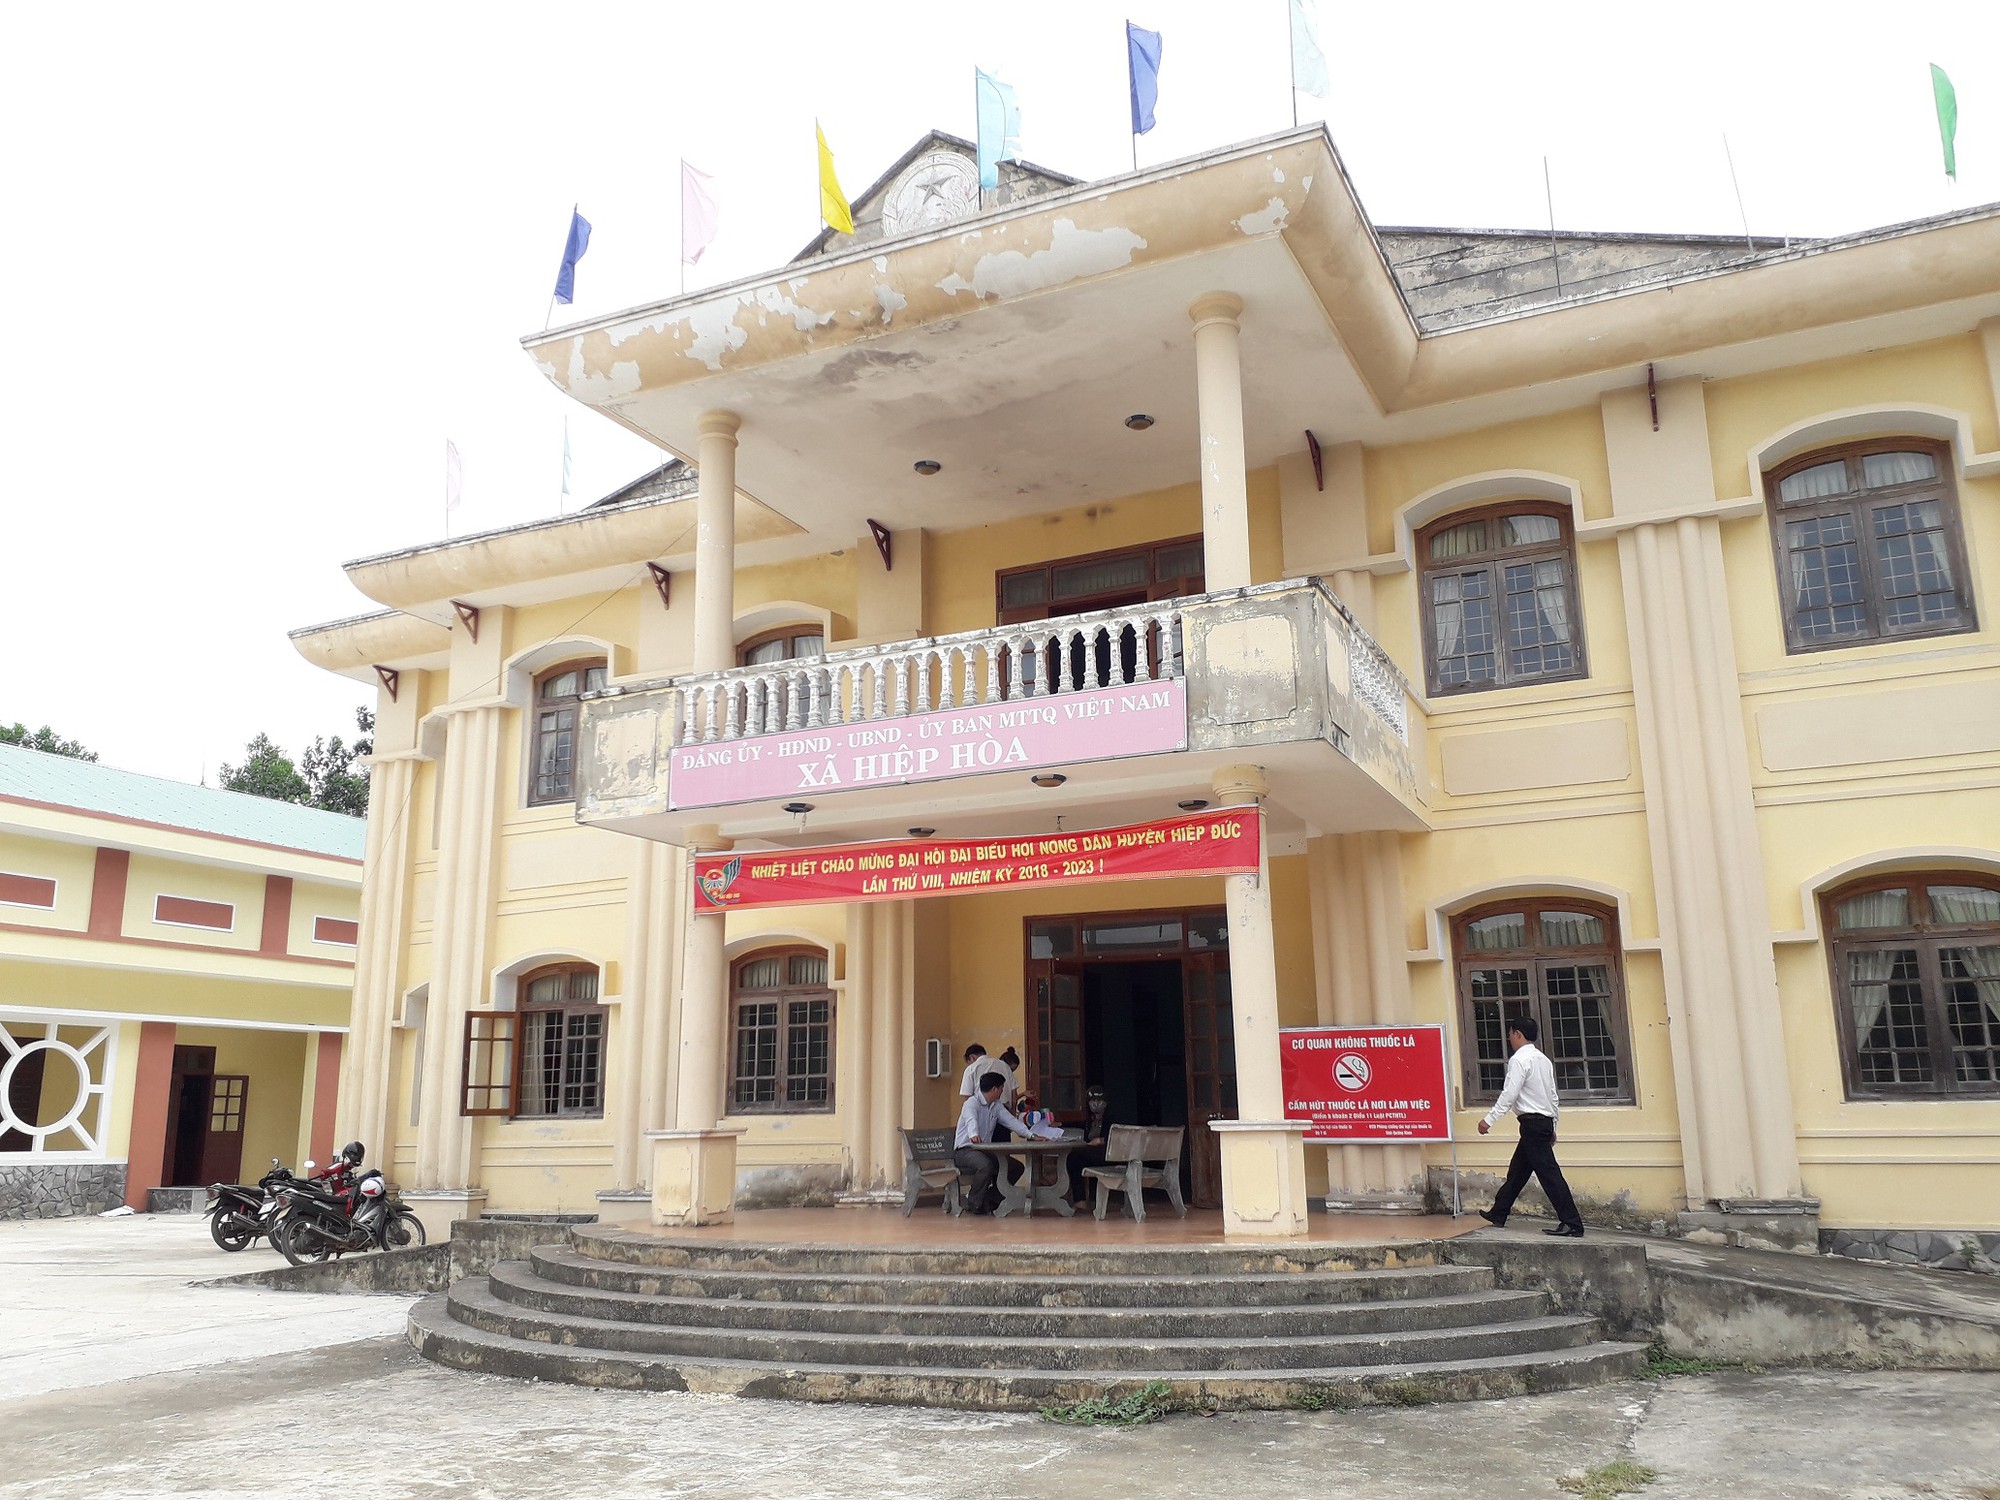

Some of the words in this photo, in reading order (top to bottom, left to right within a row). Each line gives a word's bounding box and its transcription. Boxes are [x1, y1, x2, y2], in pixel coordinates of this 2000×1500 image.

[682, 749, 733, 770] ĐẢNG
[738, 741, 763, 762] ỦY
[778, 737, 831, 757] HĐND
[848, 727, 901, 747] UBND
[919, 718, 946, 739] ỦY
[951, 715, 993, 735] BAN
[999, 706, 1058, 729] MTTQ
[1063, 697, 1114, 721] VIỆT
[1120, 690, 1170, 713] NAM
[797, 753, 841, 789] XÃ
[853, 743, 939, 783] HIỆP
[950, 733, 1029, 770] HÒA
[751, 861, 787, 881] NHIỆT
[791, 859, 817, 880] LIỆT
[821, 855, 854, 873] CHÀO
[858, 853, 894, 871] MỪNG
[898, 852, 919, 870] ĐẠI
[924, 848, 945, 868] HỘI
[950, 847, 971, 866] ĐẠI
[1082, 834, 1112, 851] DÂN
[1116, 829, 1166, 848] HUYỆN
[1171, 824, 1206, 846] HIỆP
[1211, 820, 1241, 839] ĐỨC
[862, 875, 887, 894] LẦN
[892, 873, 918, 891] THỨ
[922, 874, 945, 889] VIII,
[950, 868, 992, 888] NHIỆM
[995, 864, 1014, 882] KỲ
[1018, 864, 1049, 880] 2018
[1062, 860, 1094, 876] 2023
[1292, 1038, 1304, 1050] CƠ
[1307, 1038, 1332, 1050] QUAN
[1334, 1036, 1367, 1049] KHÔNG
[1369, 1033, 1400, 1048] THUỐC
[1403, 1034, 1415, 1047] LÁ
[1288, 1100, 1307, 1110] CẤM
[1309, 1100, 1326, 1110] HÚT
[1327, 1098, 1356, 1110] THUỐC
[1358, 1099, 1370, 1110] LÁ
[1371, 1100, 1387, 1110] NƠI
[1389, 1099, 1408, 1110] LÀM
[1410, 1099, 1431, 1111] VIỆC
